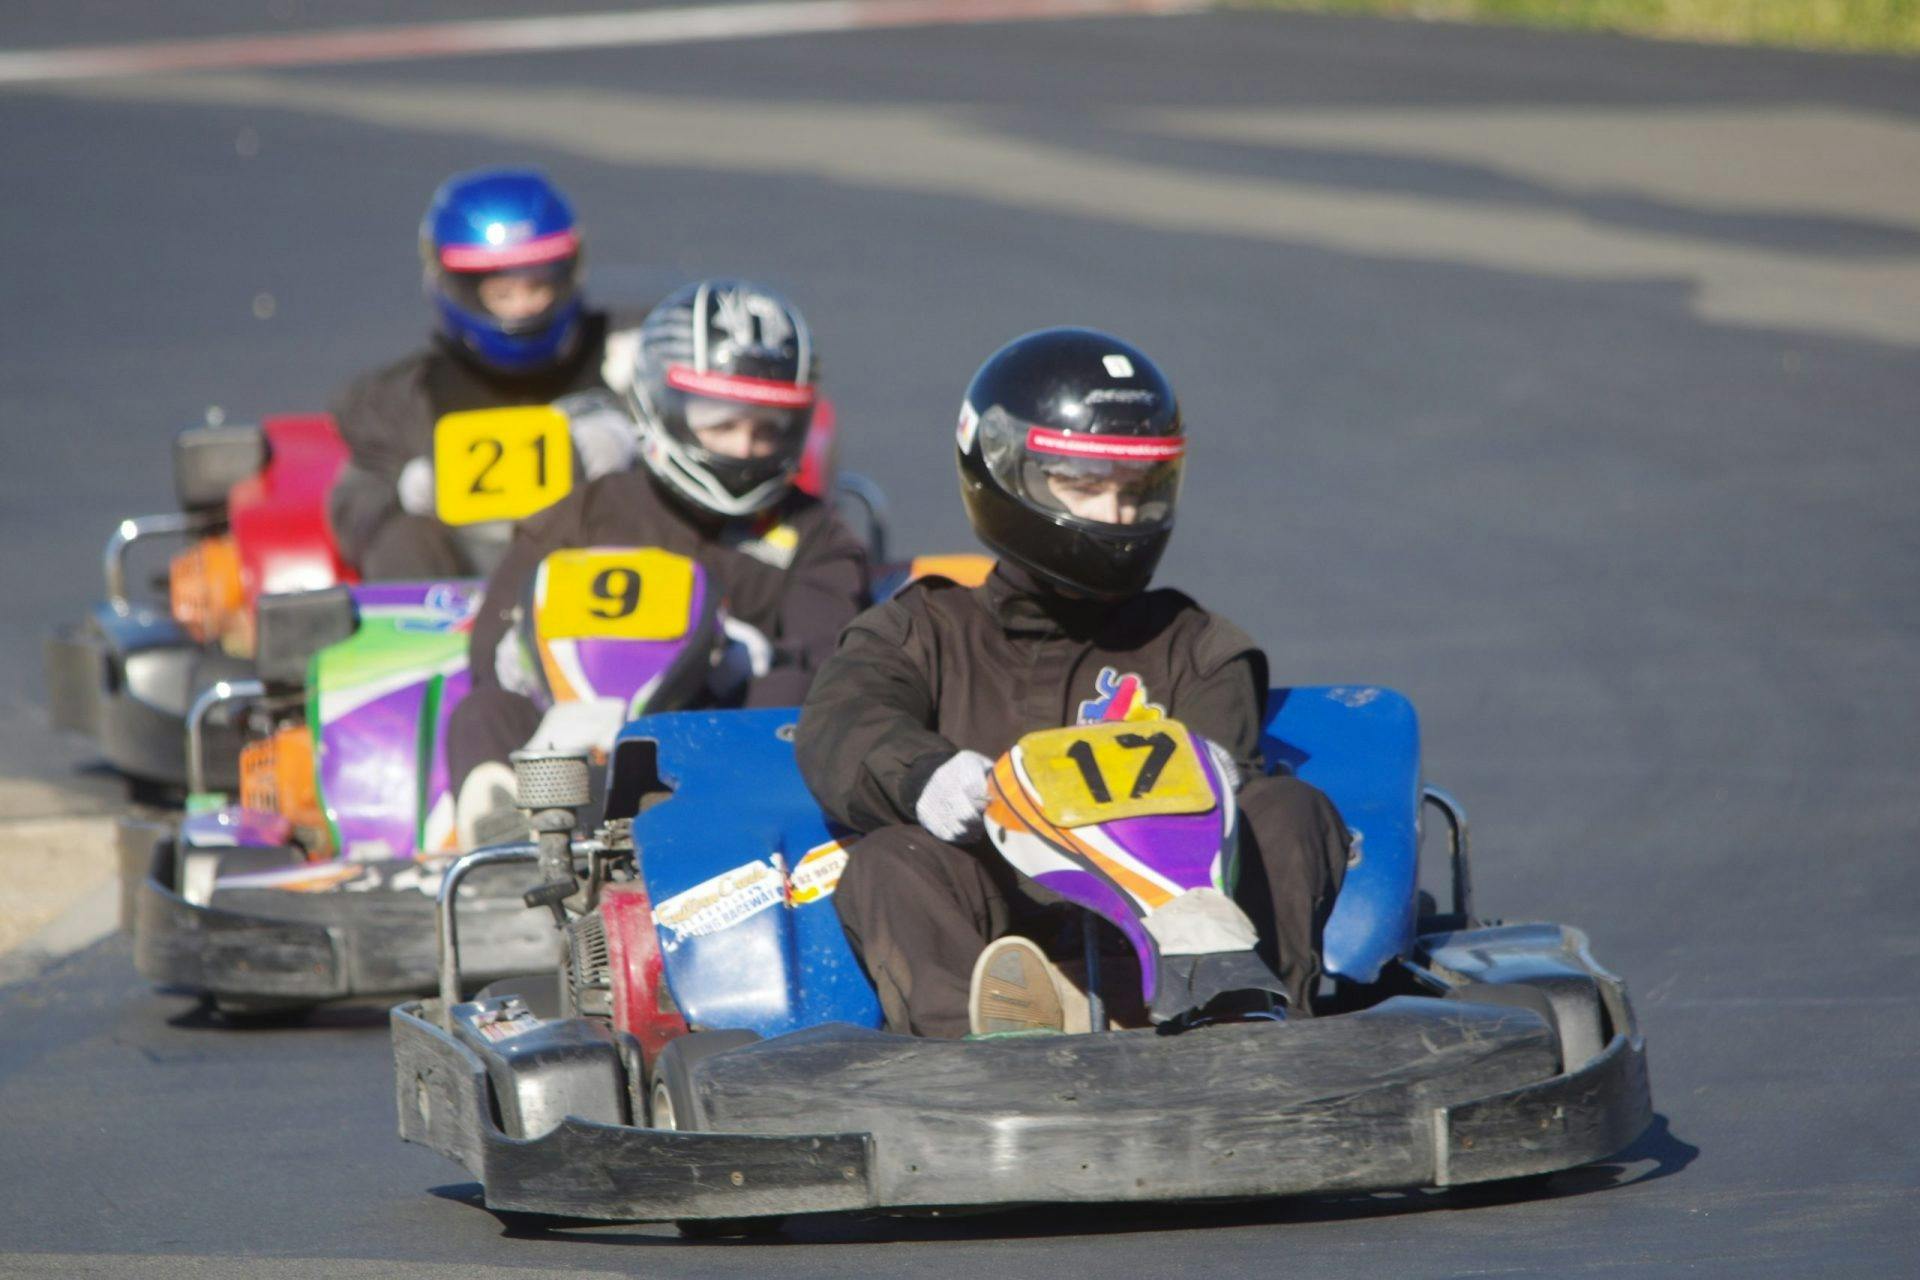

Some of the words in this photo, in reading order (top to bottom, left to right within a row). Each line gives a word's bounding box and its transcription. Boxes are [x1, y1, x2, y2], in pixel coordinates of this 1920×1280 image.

[468, 434, 547, 495] 21
[587, 566, 642, 620] 9
[1066, 731, 1178, 804] 17
